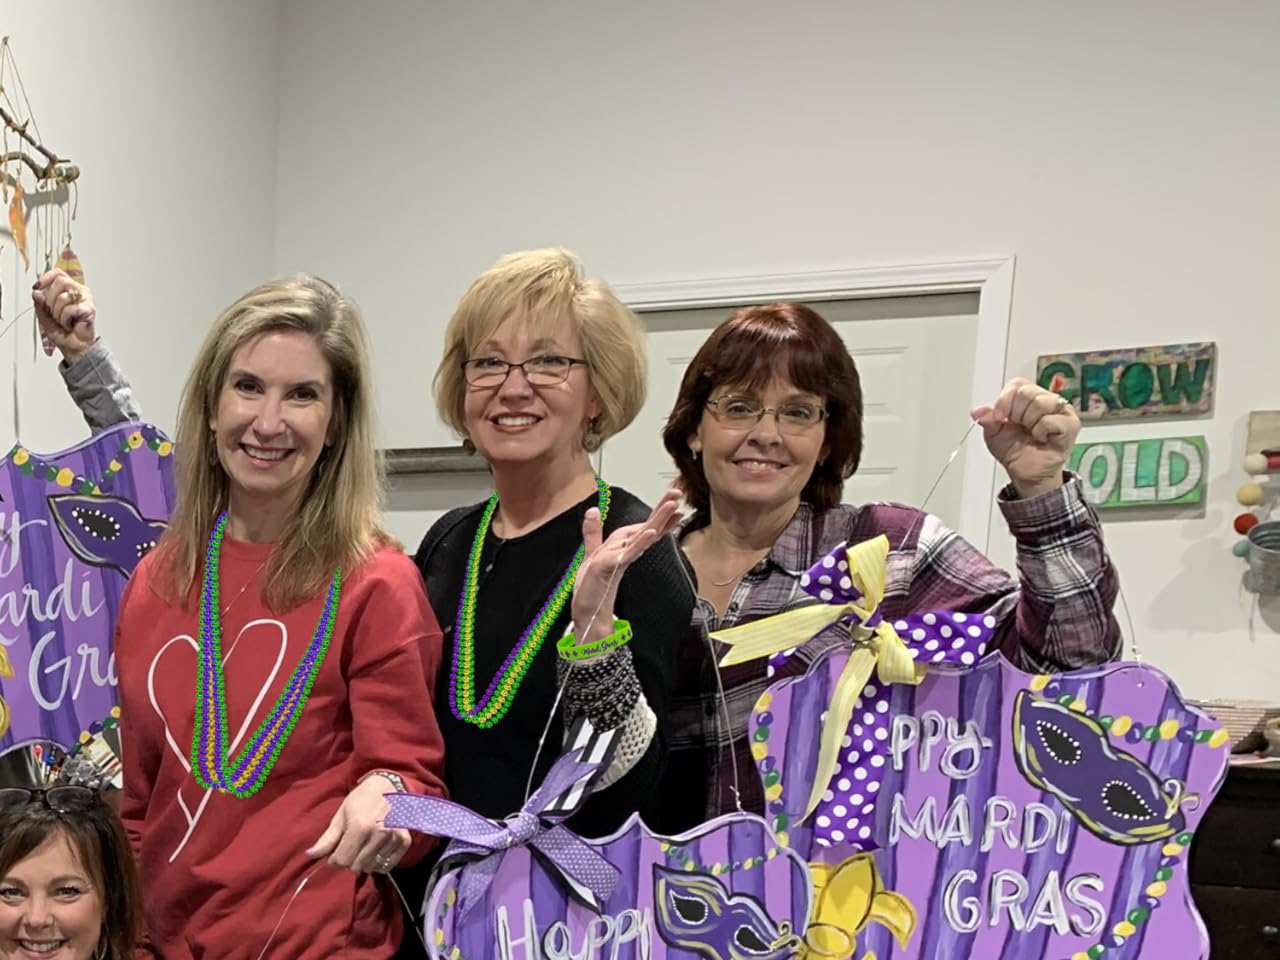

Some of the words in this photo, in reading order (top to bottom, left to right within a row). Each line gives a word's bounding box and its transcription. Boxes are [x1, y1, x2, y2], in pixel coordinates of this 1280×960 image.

[1039, 358, 1210, 412] GROW
[1077, 438, 1202, 504] OLD
[29, 630, 118, 711] Gr
[887, 709, 992, 779] ppy
[888, 793, 1070, 854] MARDI
[943, 869, 1106, 937] GRAS
